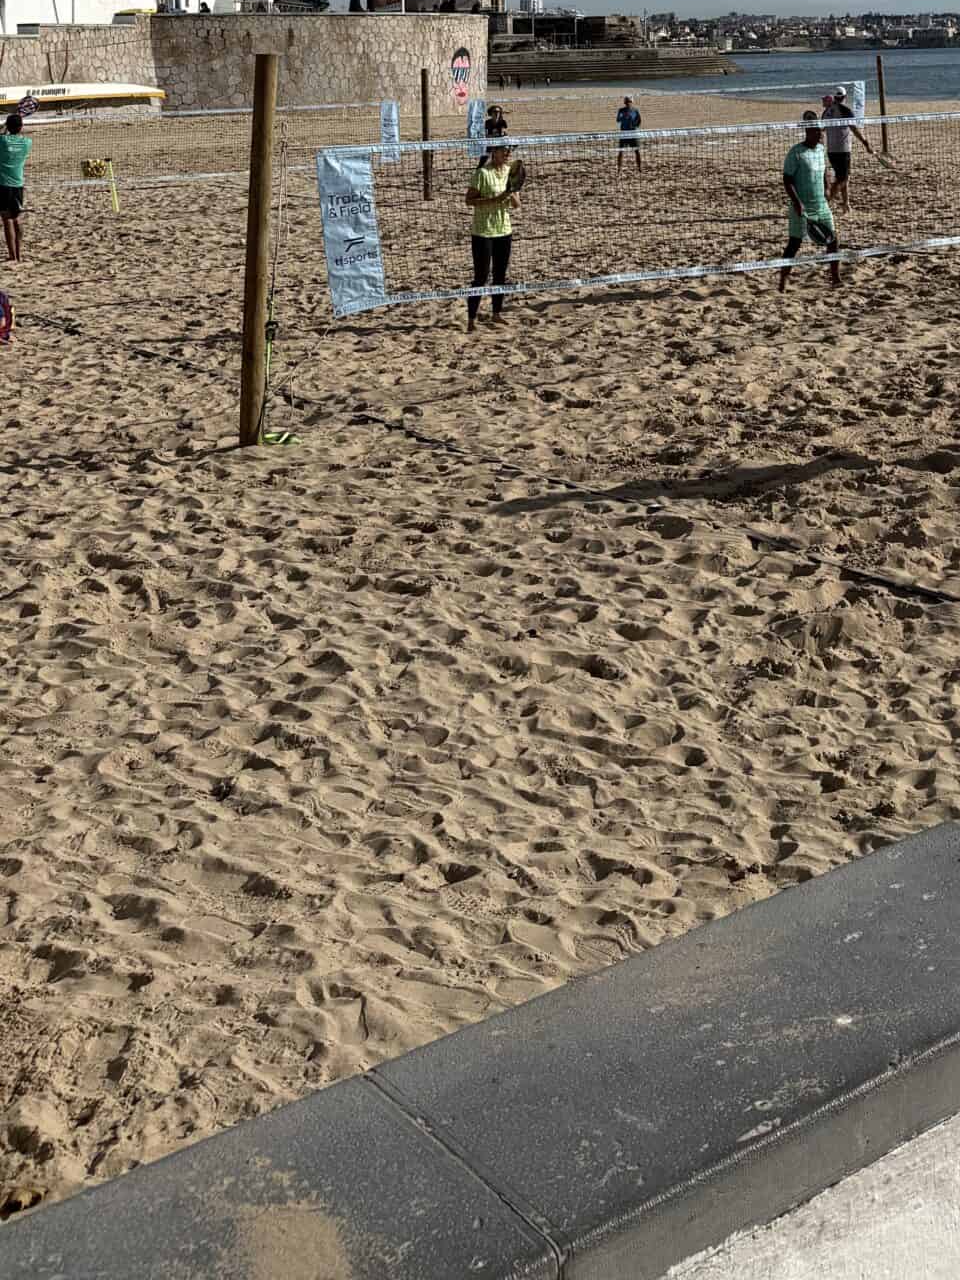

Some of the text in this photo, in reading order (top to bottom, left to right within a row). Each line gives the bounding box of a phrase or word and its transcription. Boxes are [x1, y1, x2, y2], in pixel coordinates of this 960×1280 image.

[328, 191, 367, 206] Track
[329, 202, 371, 219] & Field
